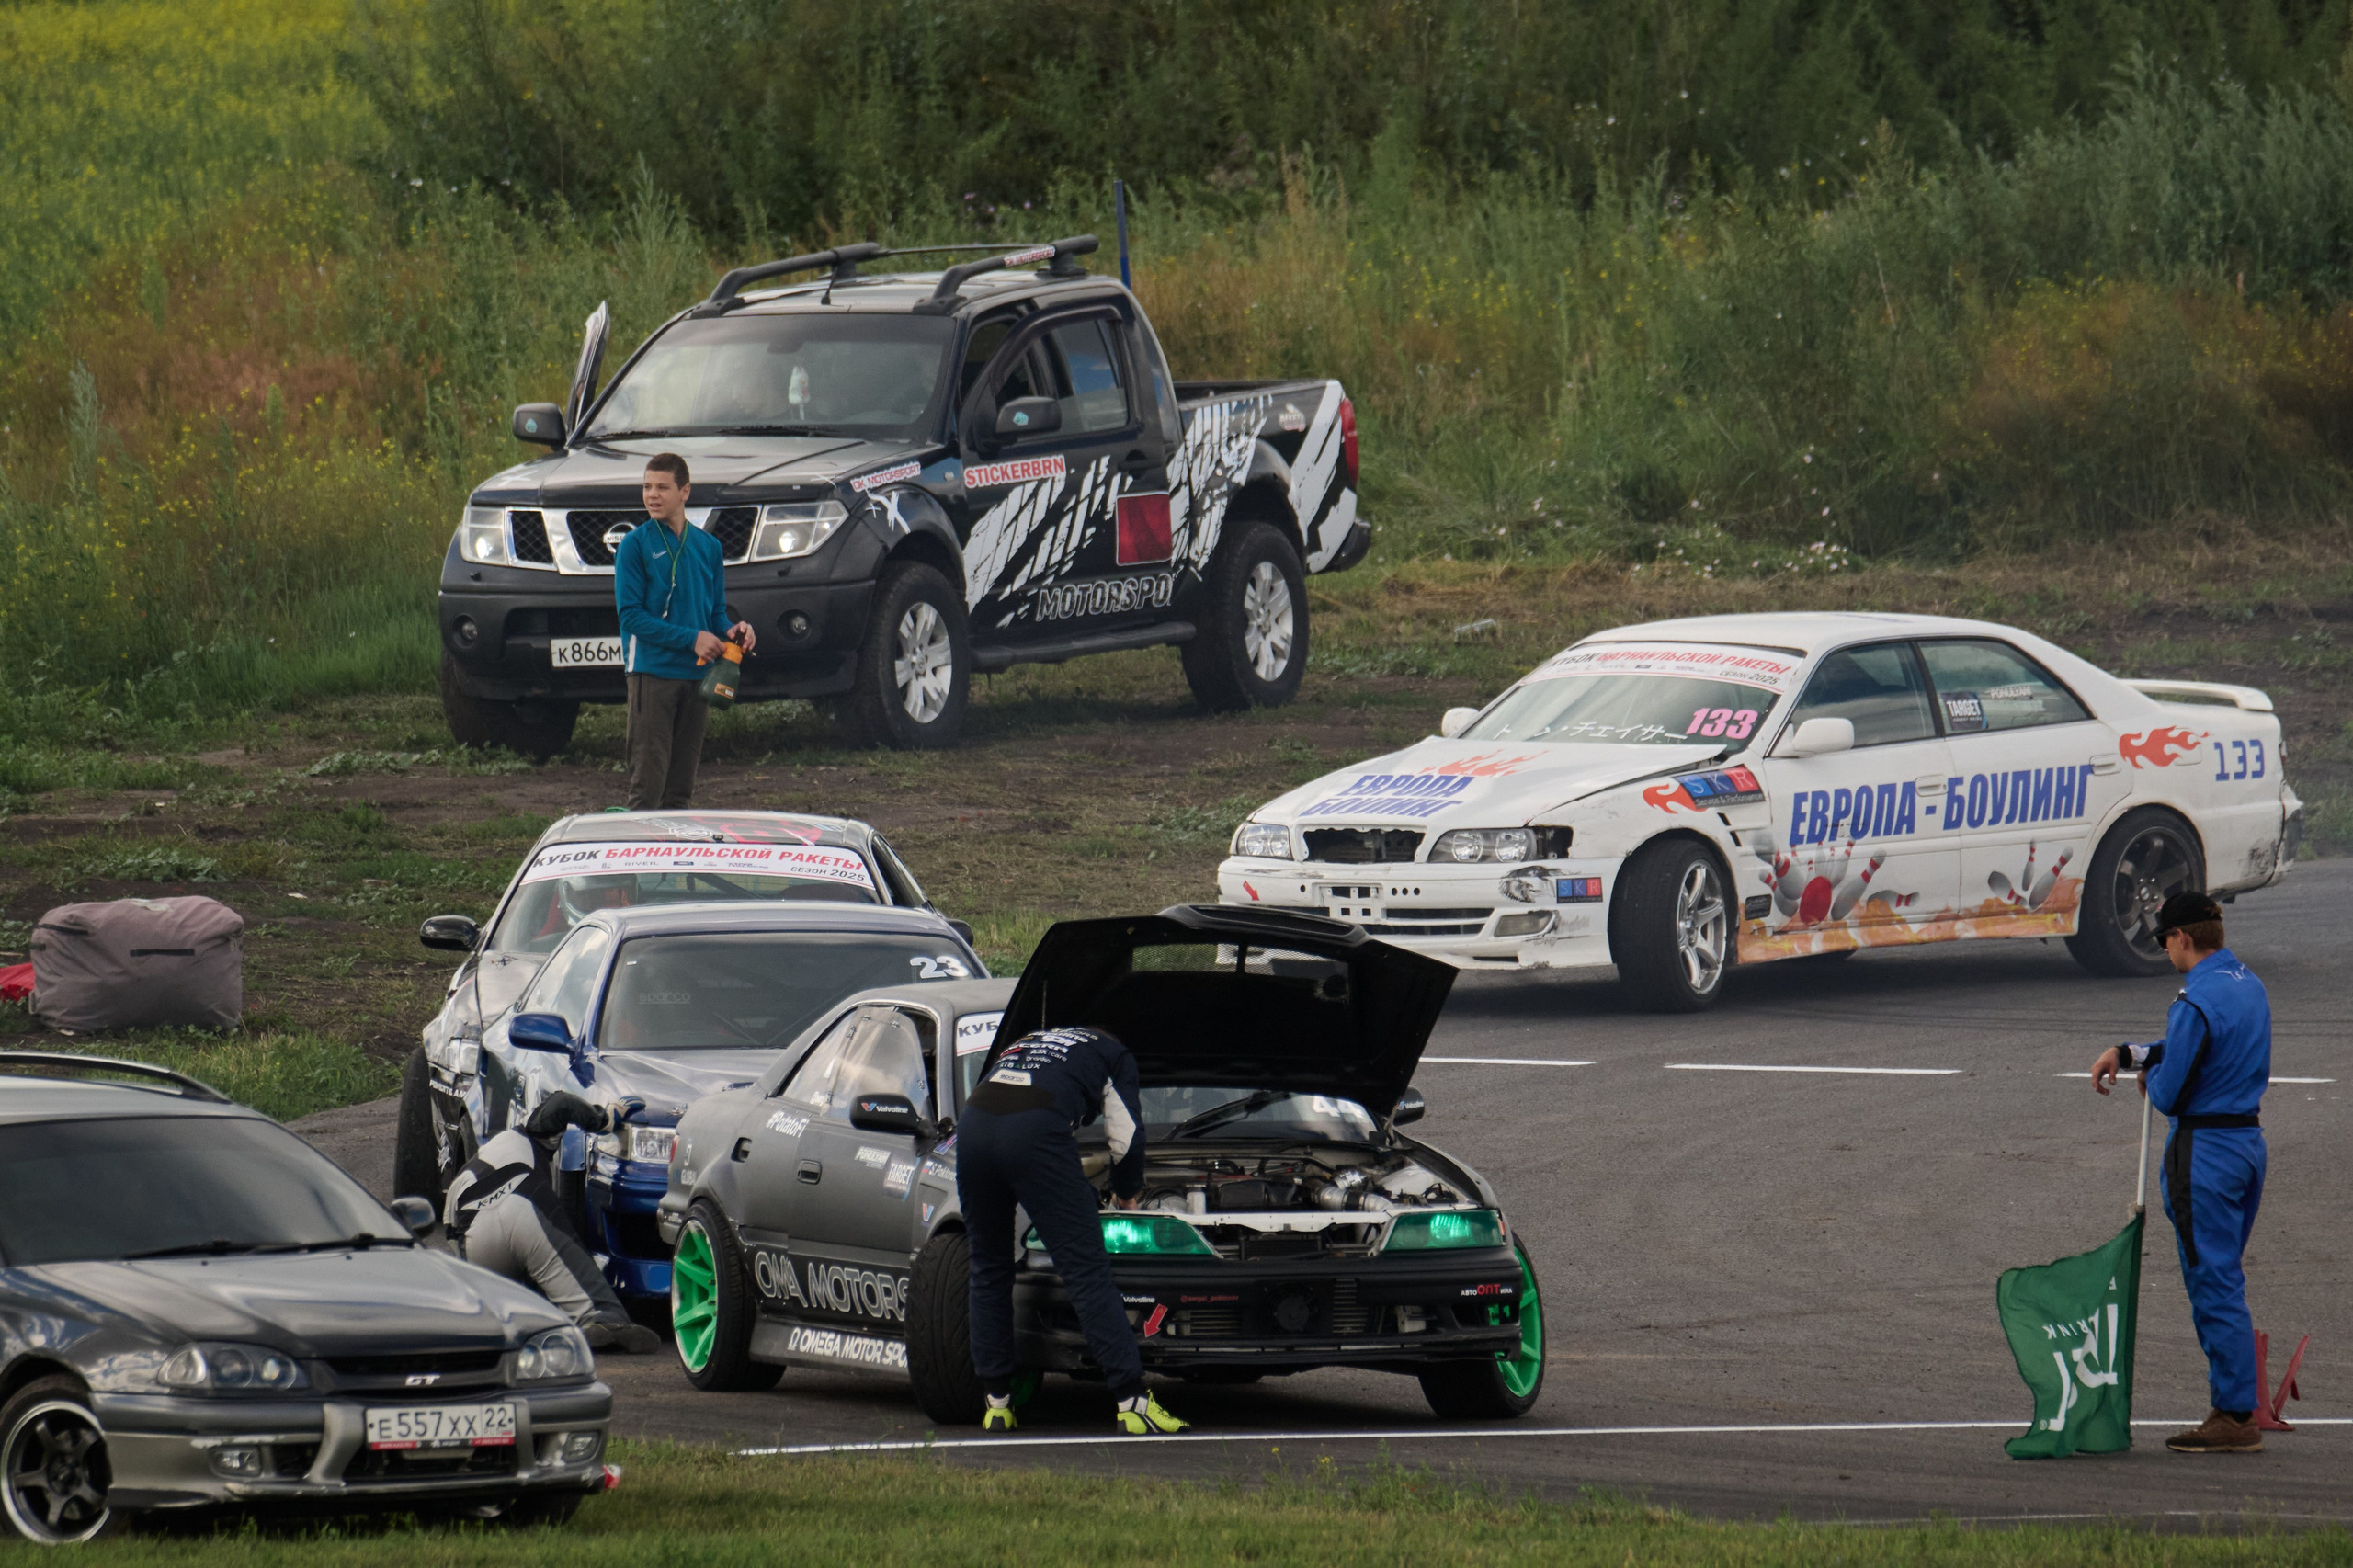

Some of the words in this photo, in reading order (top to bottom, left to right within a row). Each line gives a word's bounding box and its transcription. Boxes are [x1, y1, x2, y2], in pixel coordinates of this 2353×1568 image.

[867, 464, 920, 487] MOTORSPORT
[965, 458, 1064, 485] STICKERBRN
[1036, 574, 1172, 621] MOTORSPO
[1551, 653, 1598, 667] КУБОК
[1597, 651, 1722, 665] БАРНАУЛЬСКОЙ
[1720, 656, 1791, 675] РАКЕТЫ
[1720, 671, 1748, 679] СЕЗОН
[1749, 673, 1780, 685] 2025
[1947, 699, 1982, 717] TARGET
[1686, 708, 1758, 739] 133
[2214, 739, 2265, 781] 133
[1335, 775, 1475, 797] ЕВРОПА
[1684, 770, 1753, 794] SKR
[1299, 798, 1463, 817] БОУЛИНГ
[1790, 781, 1916, 845] ЕВРОПА
[1943, 764, 2094, 830] БОУЛИНГ
[533, 849, 601, 868] КУБОК
[605, 846, 772, 859] БАРНАУЛЬСКОЙ
[778, 852, 862, 870] РАКЕТЫ
[790, 867, 827, 875] СЕЗОН
[830, 869, 865, 881] 2025
[1560, 881, 1598, 894] SKR
[910, 956, 969, 979] 23
[640, 993, 690, 1005] sparco
[958, 1021, 998, 1037] КУБ
[888, 1163, 915, 1185] TARGET
[800, 1330, 841, 1358] OMEGA
[841, 1335, 884, 1364] MOTOR
[405, 1374, 440, 1386] GT
[485, 1407, 507, 1427] 22
